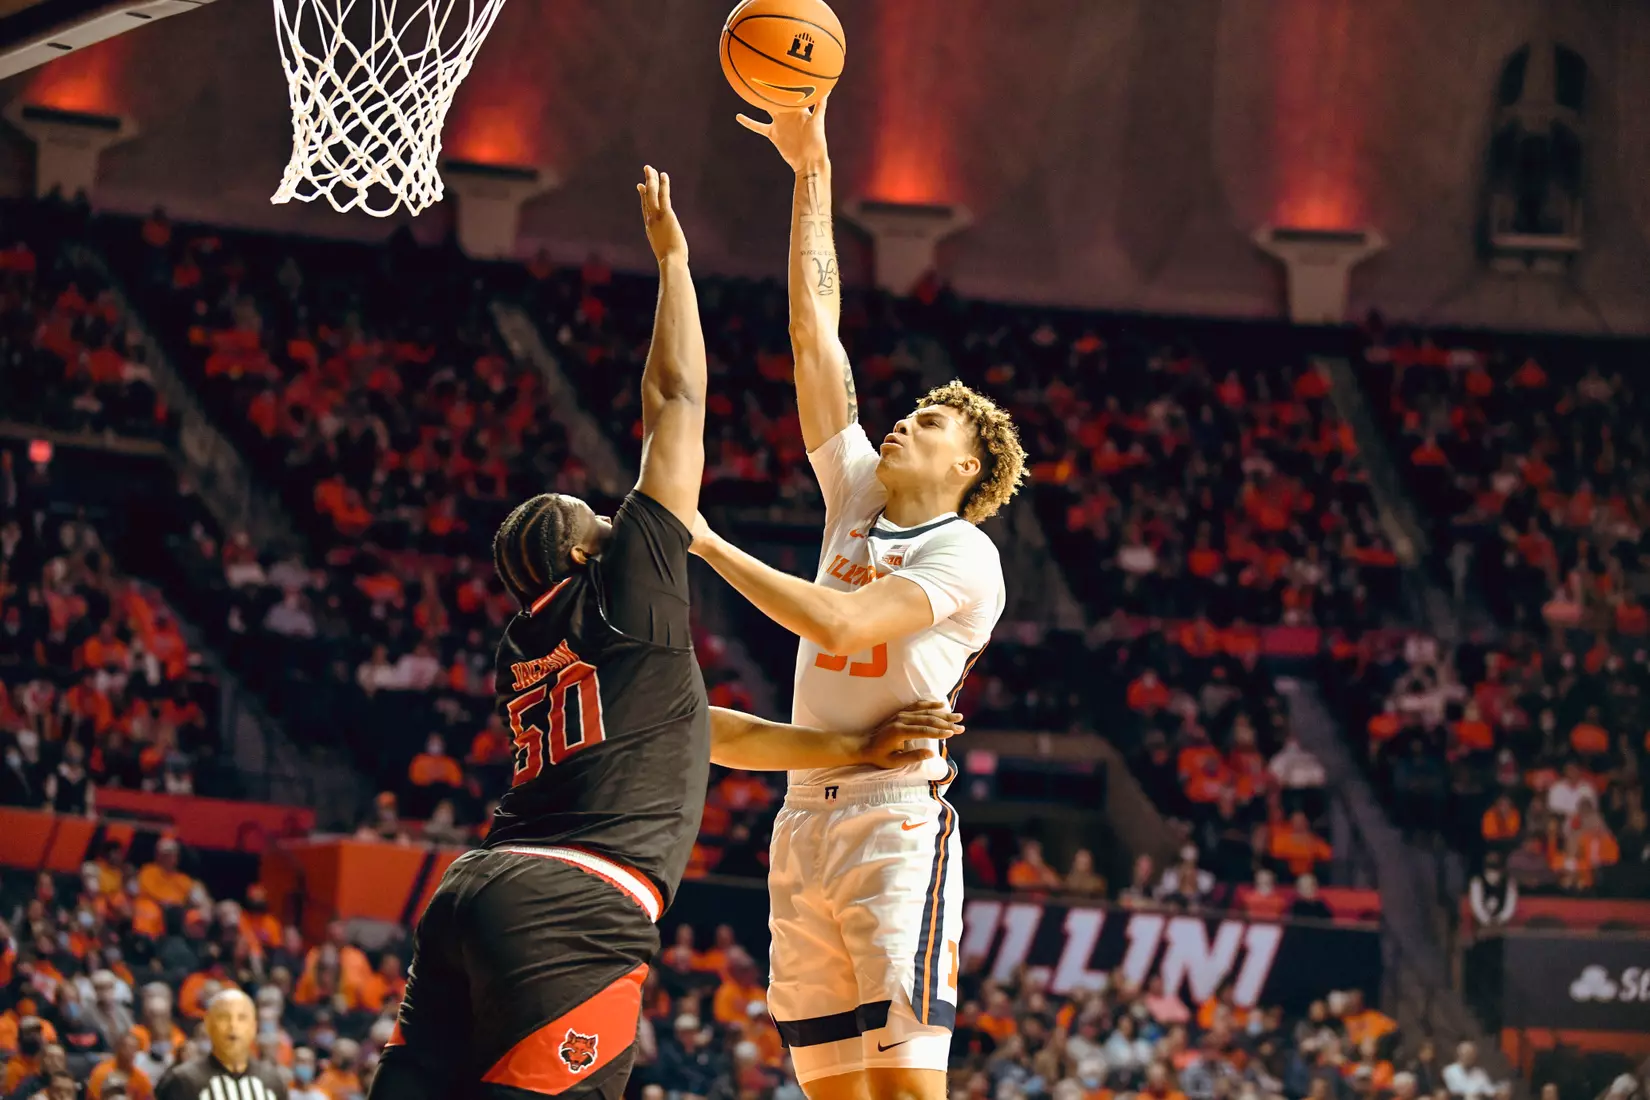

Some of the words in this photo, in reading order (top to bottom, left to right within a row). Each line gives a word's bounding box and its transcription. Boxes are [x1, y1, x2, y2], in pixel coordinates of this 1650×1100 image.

[510, 638, 580, 692] JACKSON
[507, 660, 606, 789] 50
[958, 900, 1283, 1008] ILLINI
